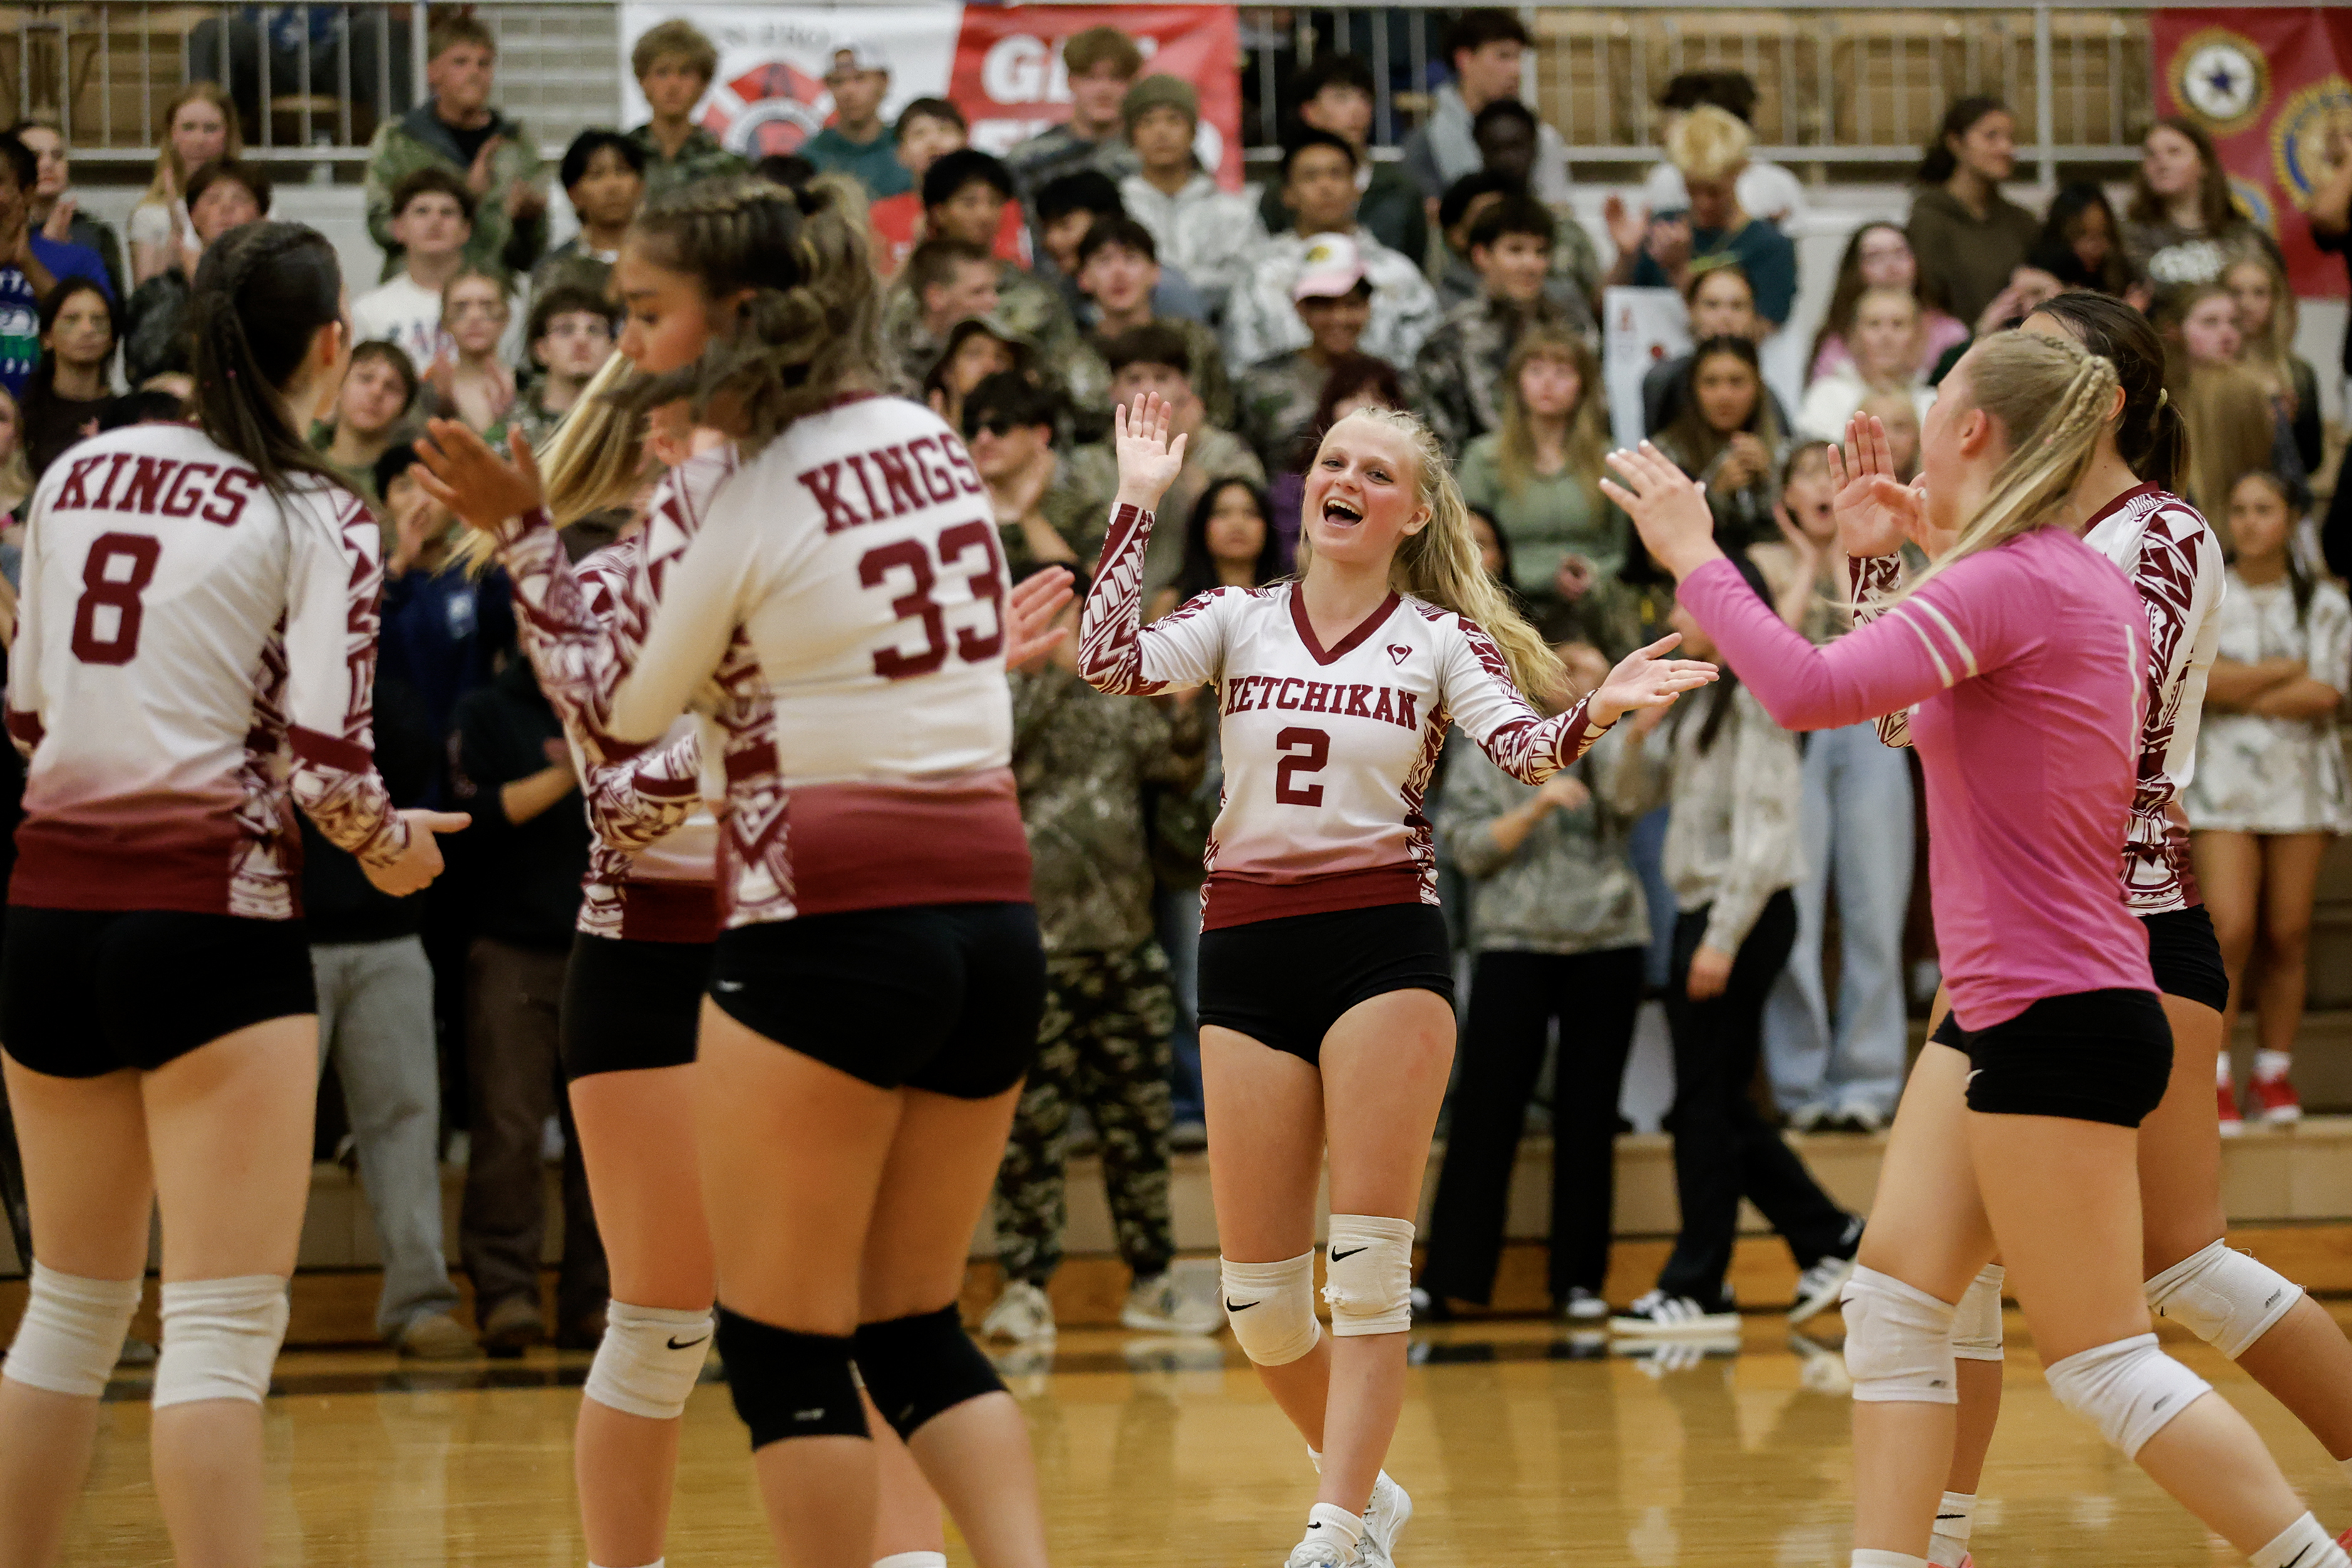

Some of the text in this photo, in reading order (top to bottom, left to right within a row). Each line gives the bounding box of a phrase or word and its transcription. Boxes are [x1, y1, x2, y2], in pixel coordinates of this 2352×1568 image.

[52, 452, 261, 527] KINGS
[797, 433, 982, 535] KINGS
[71, 531, 163, 666] 8
[859, 519, 1004, 680] 33
[1224, 675, 1418, 731] KETCHIKAN
[1275, 726, 1331, 808] 2
